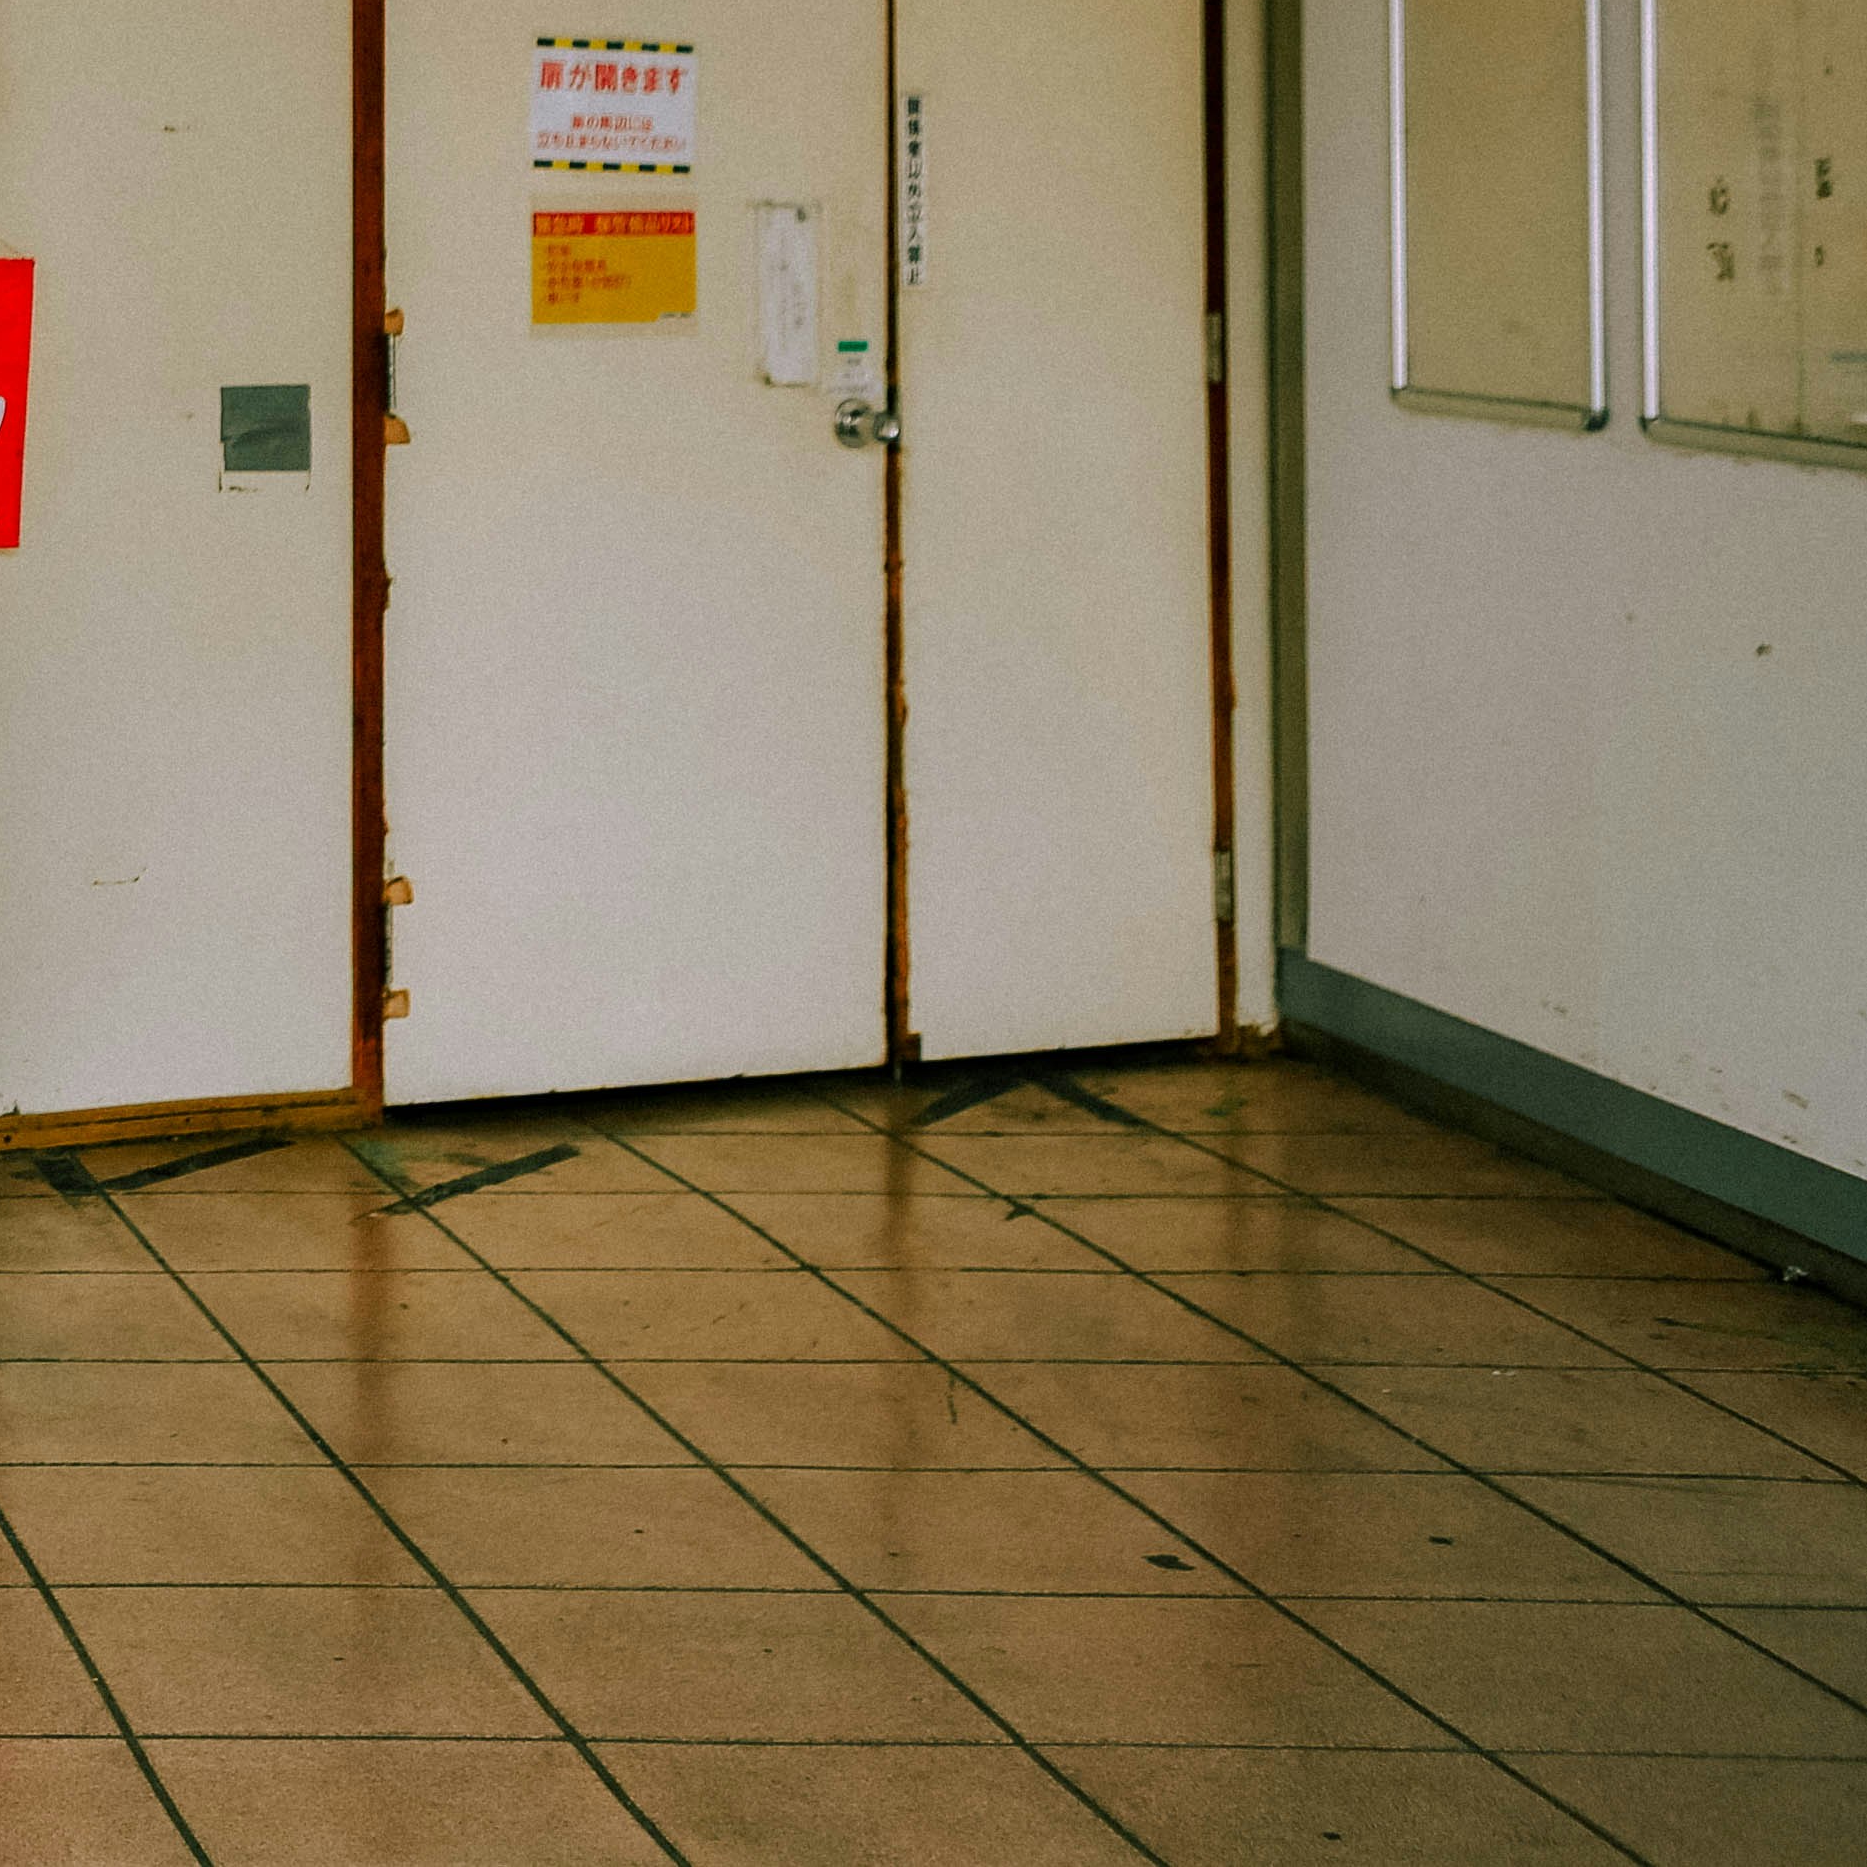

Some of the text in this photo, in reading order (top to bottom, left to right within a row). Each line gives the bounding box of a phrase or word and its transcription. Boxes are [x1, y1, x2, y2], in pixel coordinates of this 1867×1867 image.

[540, 60, 689, 96] 扉が開きます
